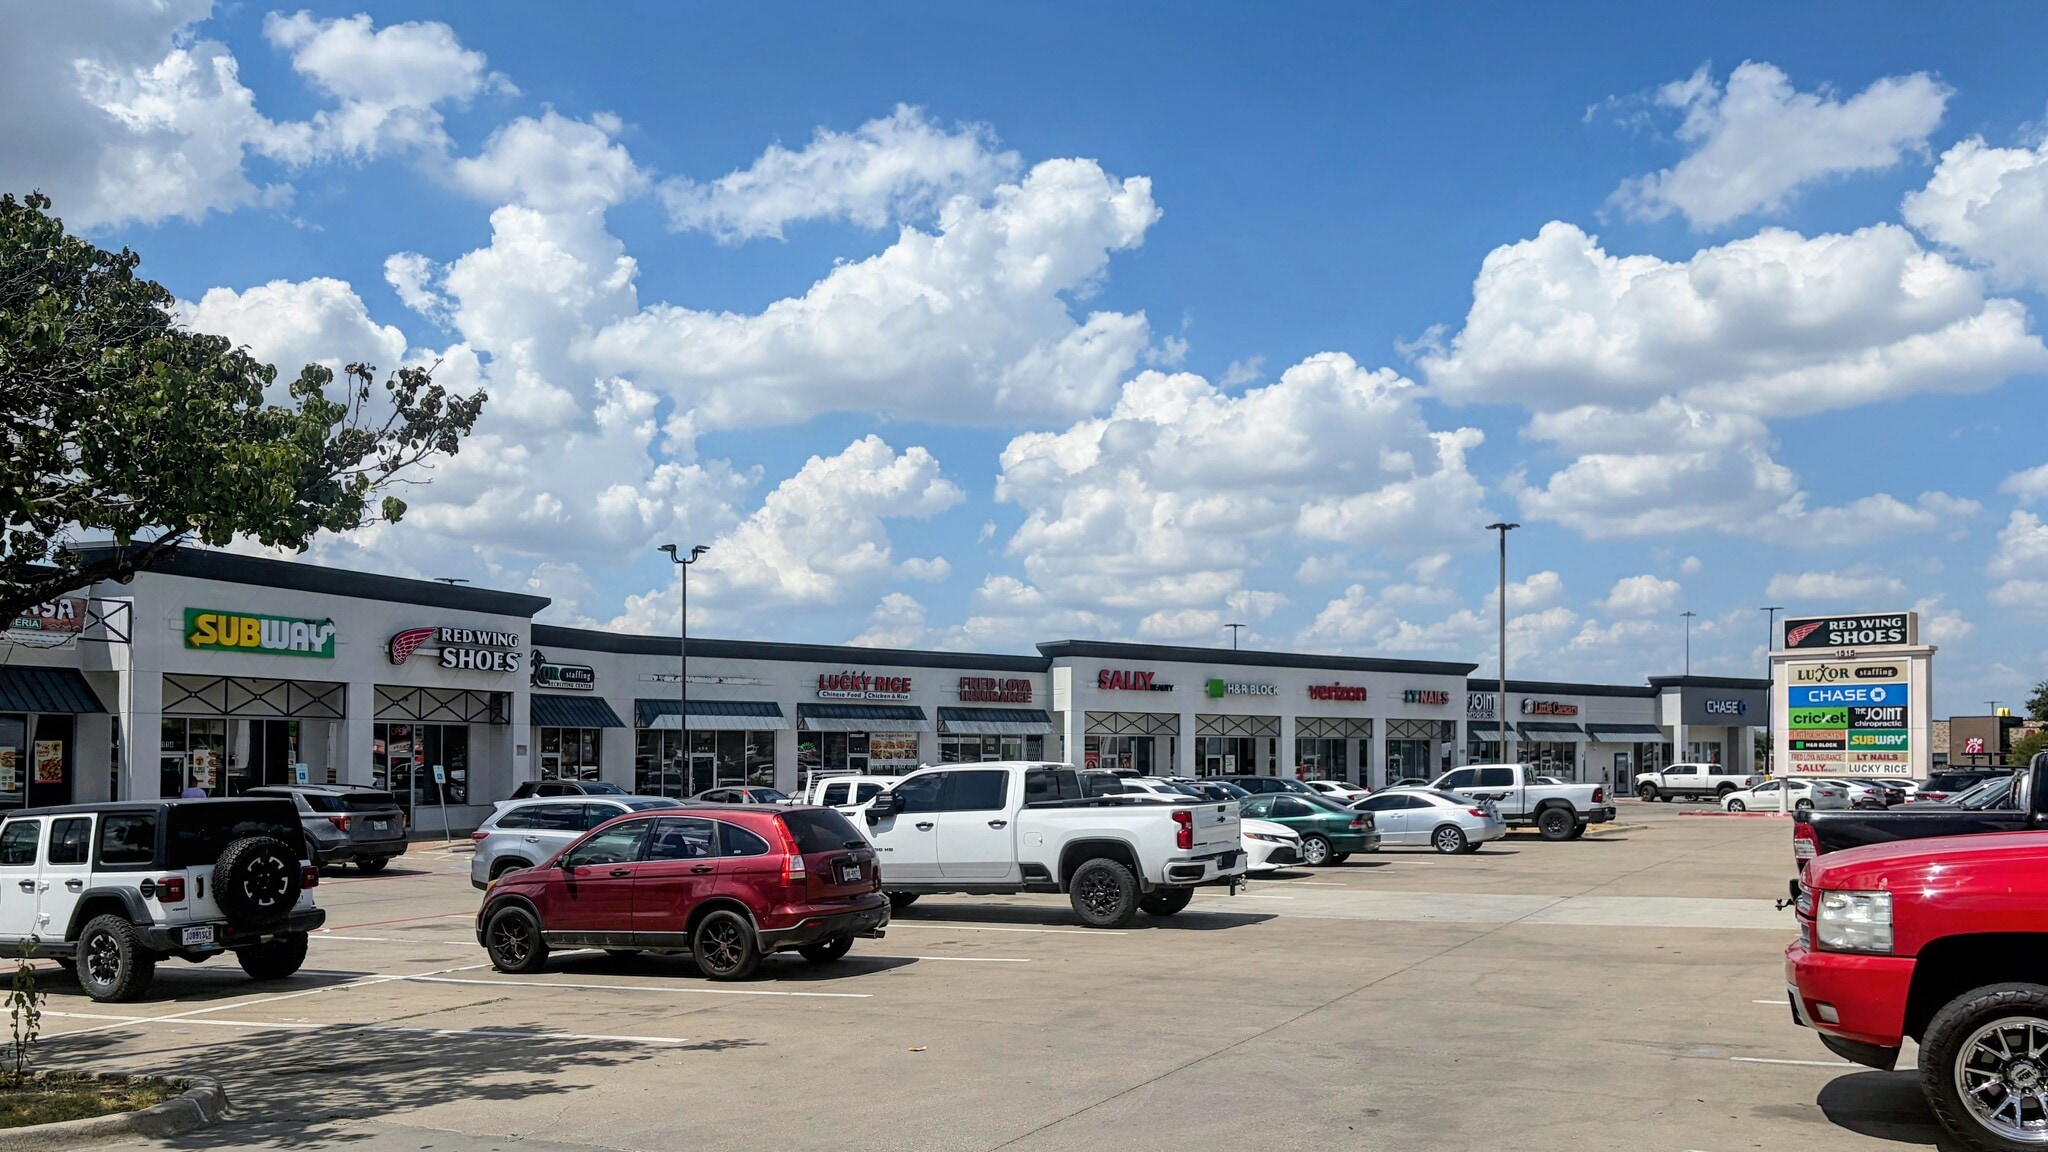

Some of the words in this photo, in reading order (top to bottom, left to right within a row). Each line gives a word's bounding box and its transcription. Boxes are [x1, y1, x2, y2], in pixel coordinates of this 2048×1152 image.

[1829, 620, 1857, 630] RED
[1860, 617, 1901, 629] WING
[188, 613, 337, 653] SUBWAY
[441, 627, 473, 644] RED
[475, 630, 520, 648] WING
[1829, 629, 1902, 645] SHOES
[441, 647, 520, 673] SHOES
[565, 670, 591, 681] staffing
[1098, 669, 1156, 691] SALLY
[1798, 664, 1850, 682] LUXOR
[1859, 668, 1893, 676] staffing
[819, 674, 872, 691] LUCKY
[874, 676, 912, 693] RICE
[960, 677, 997, 691] FRED
[999, 678, 1032, 692] LOYA
[1227, 683, 1248, 694] H&R
[1249, 684, 1279, 696] BLOCK
[960, 690, 1032, 703] INSURANCE
[1308, 681, 1367, 701] verizon
[1418, 690, 1450, 705] NAILS
[1808, 689, 1867, 702] CHASE
[1469, 694, 1497, 710] JOINT
[1534, 701, 1552, 714] Little
[1552, 702, 1578, 716] Caesars
[1706, 700, 1738, 714] CHASE
[1793, 712, 1846, 724] cricket
[1854, 707, 1867, 715] THE
[1864, 707, 1903, 720] JOINT
[1850, 734, 1907, 745] SUBWAY
[1791, 753, 1804, 761] FRED
[1816, 754, 1842, 762] INSURANCE
[1796, 764, 1826, 772] SALLY
[1849, 764, 1881, 773] LUCKY
[1884, 764, 1907, 773] RICE
